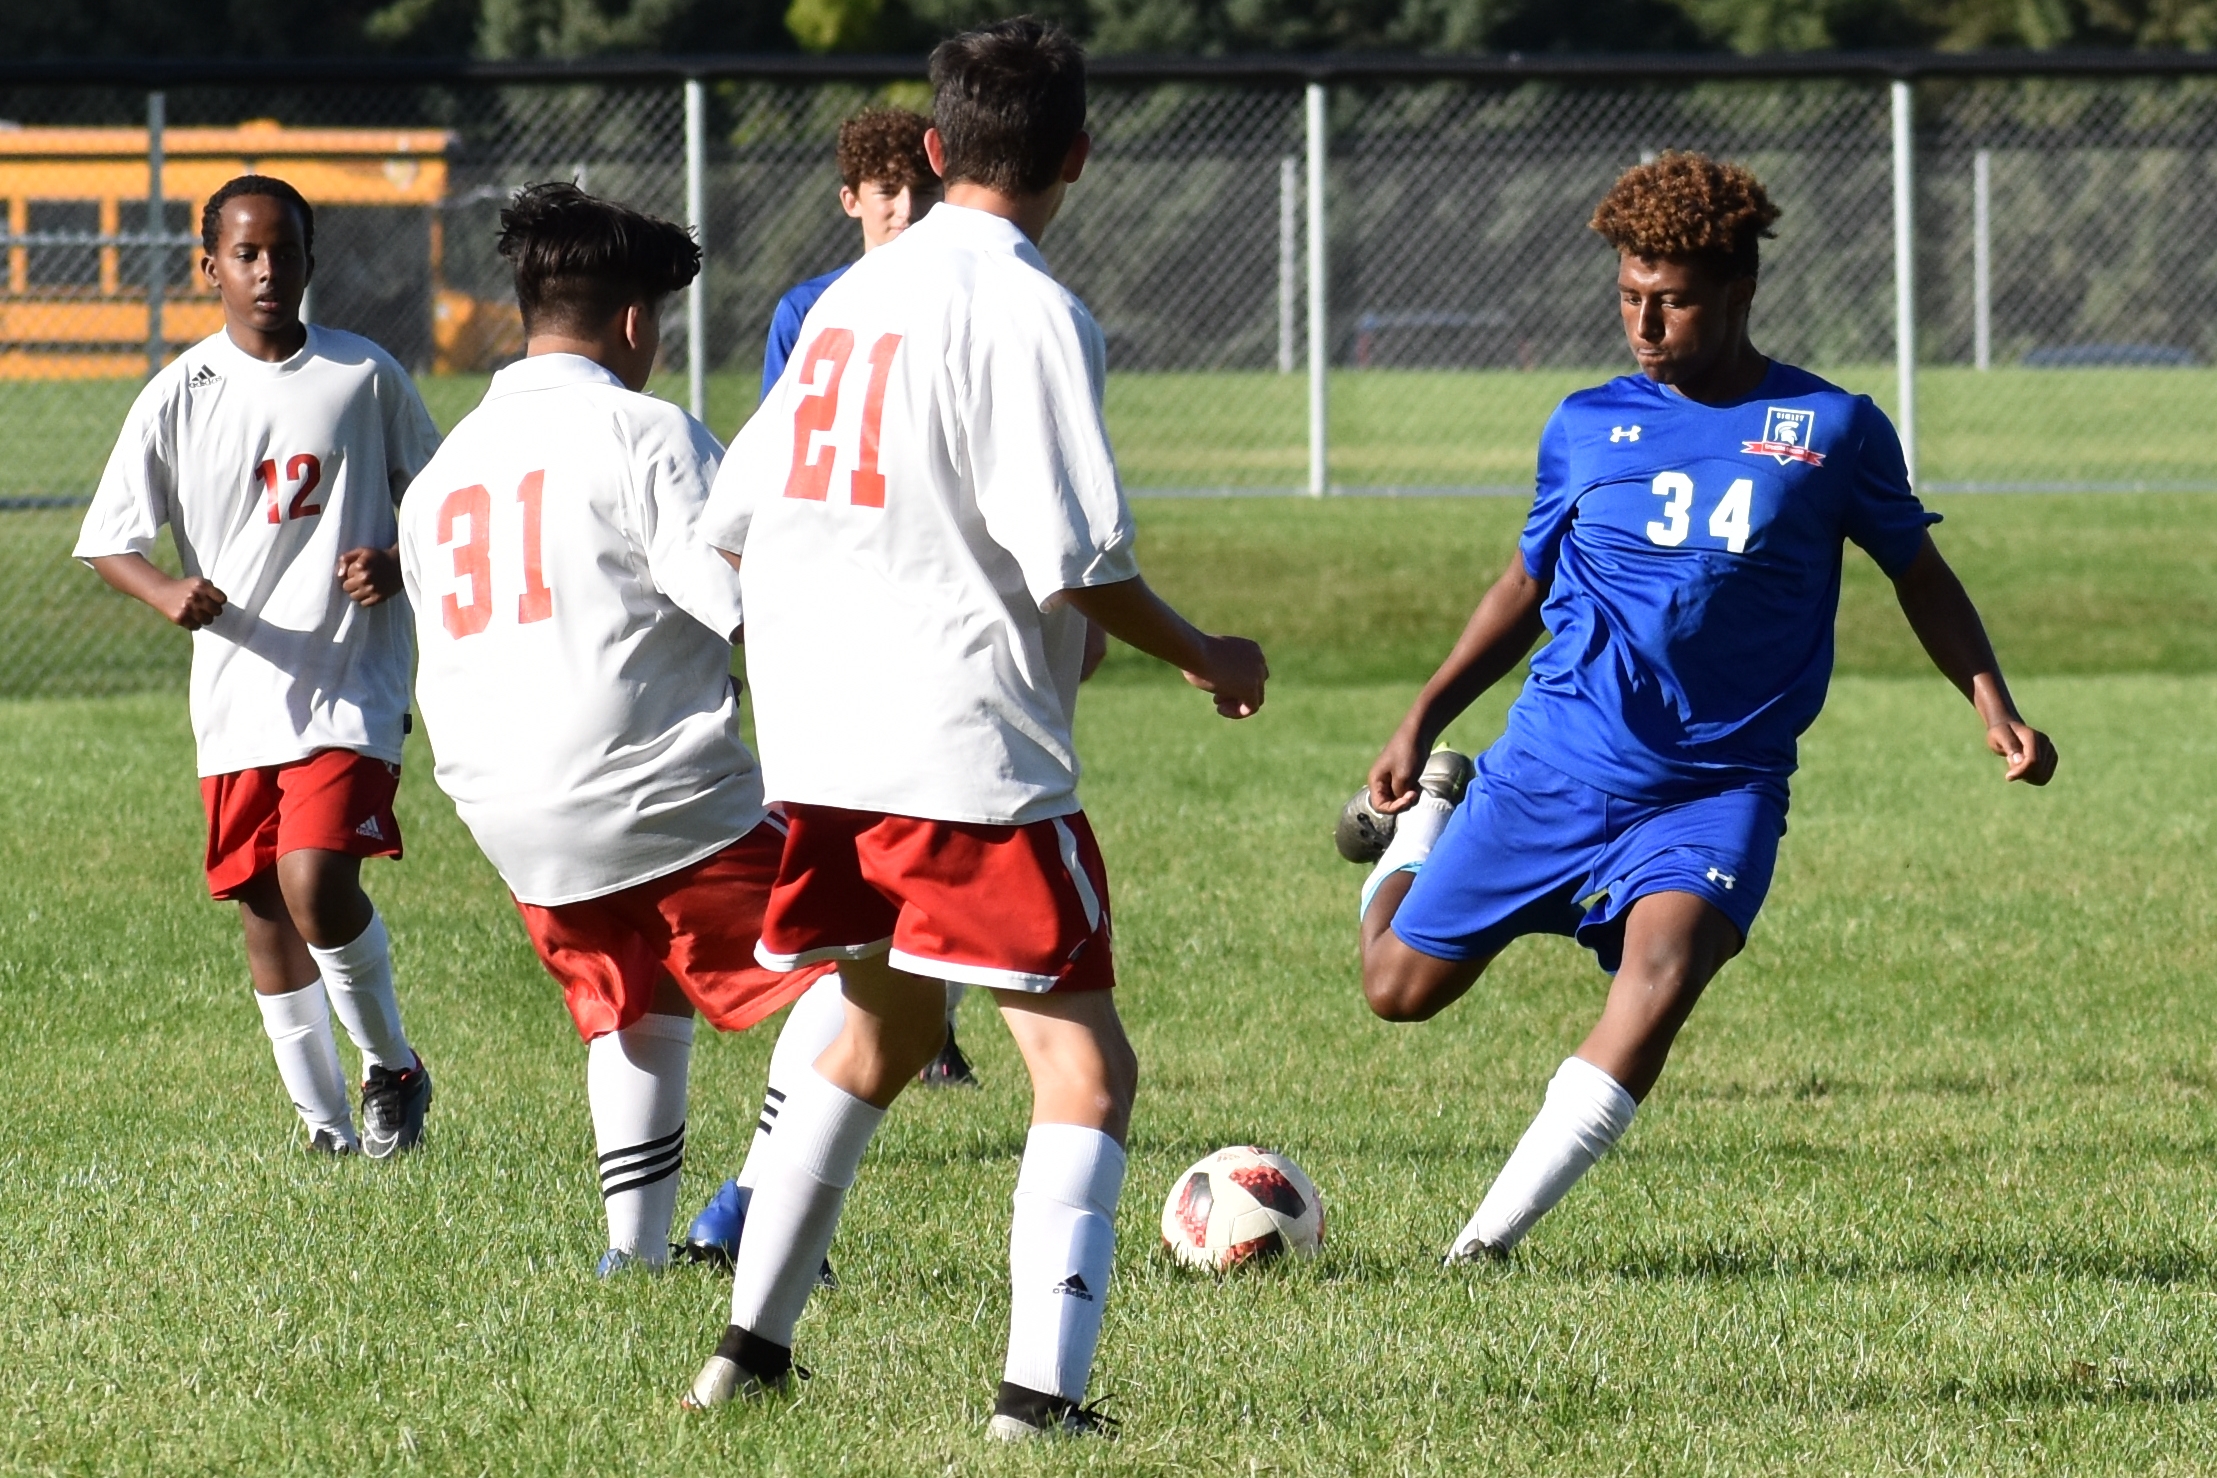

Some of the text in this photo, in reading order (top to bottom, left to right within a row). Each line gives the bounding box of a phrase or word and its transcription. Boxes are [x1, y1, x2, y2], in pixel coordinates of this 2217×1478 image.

[784, 328, 902, 509] 21
[255, 454, 320, 524] 12
[1646, 471, 1753, 554] 34
[436, 469, 553, 640] 31
